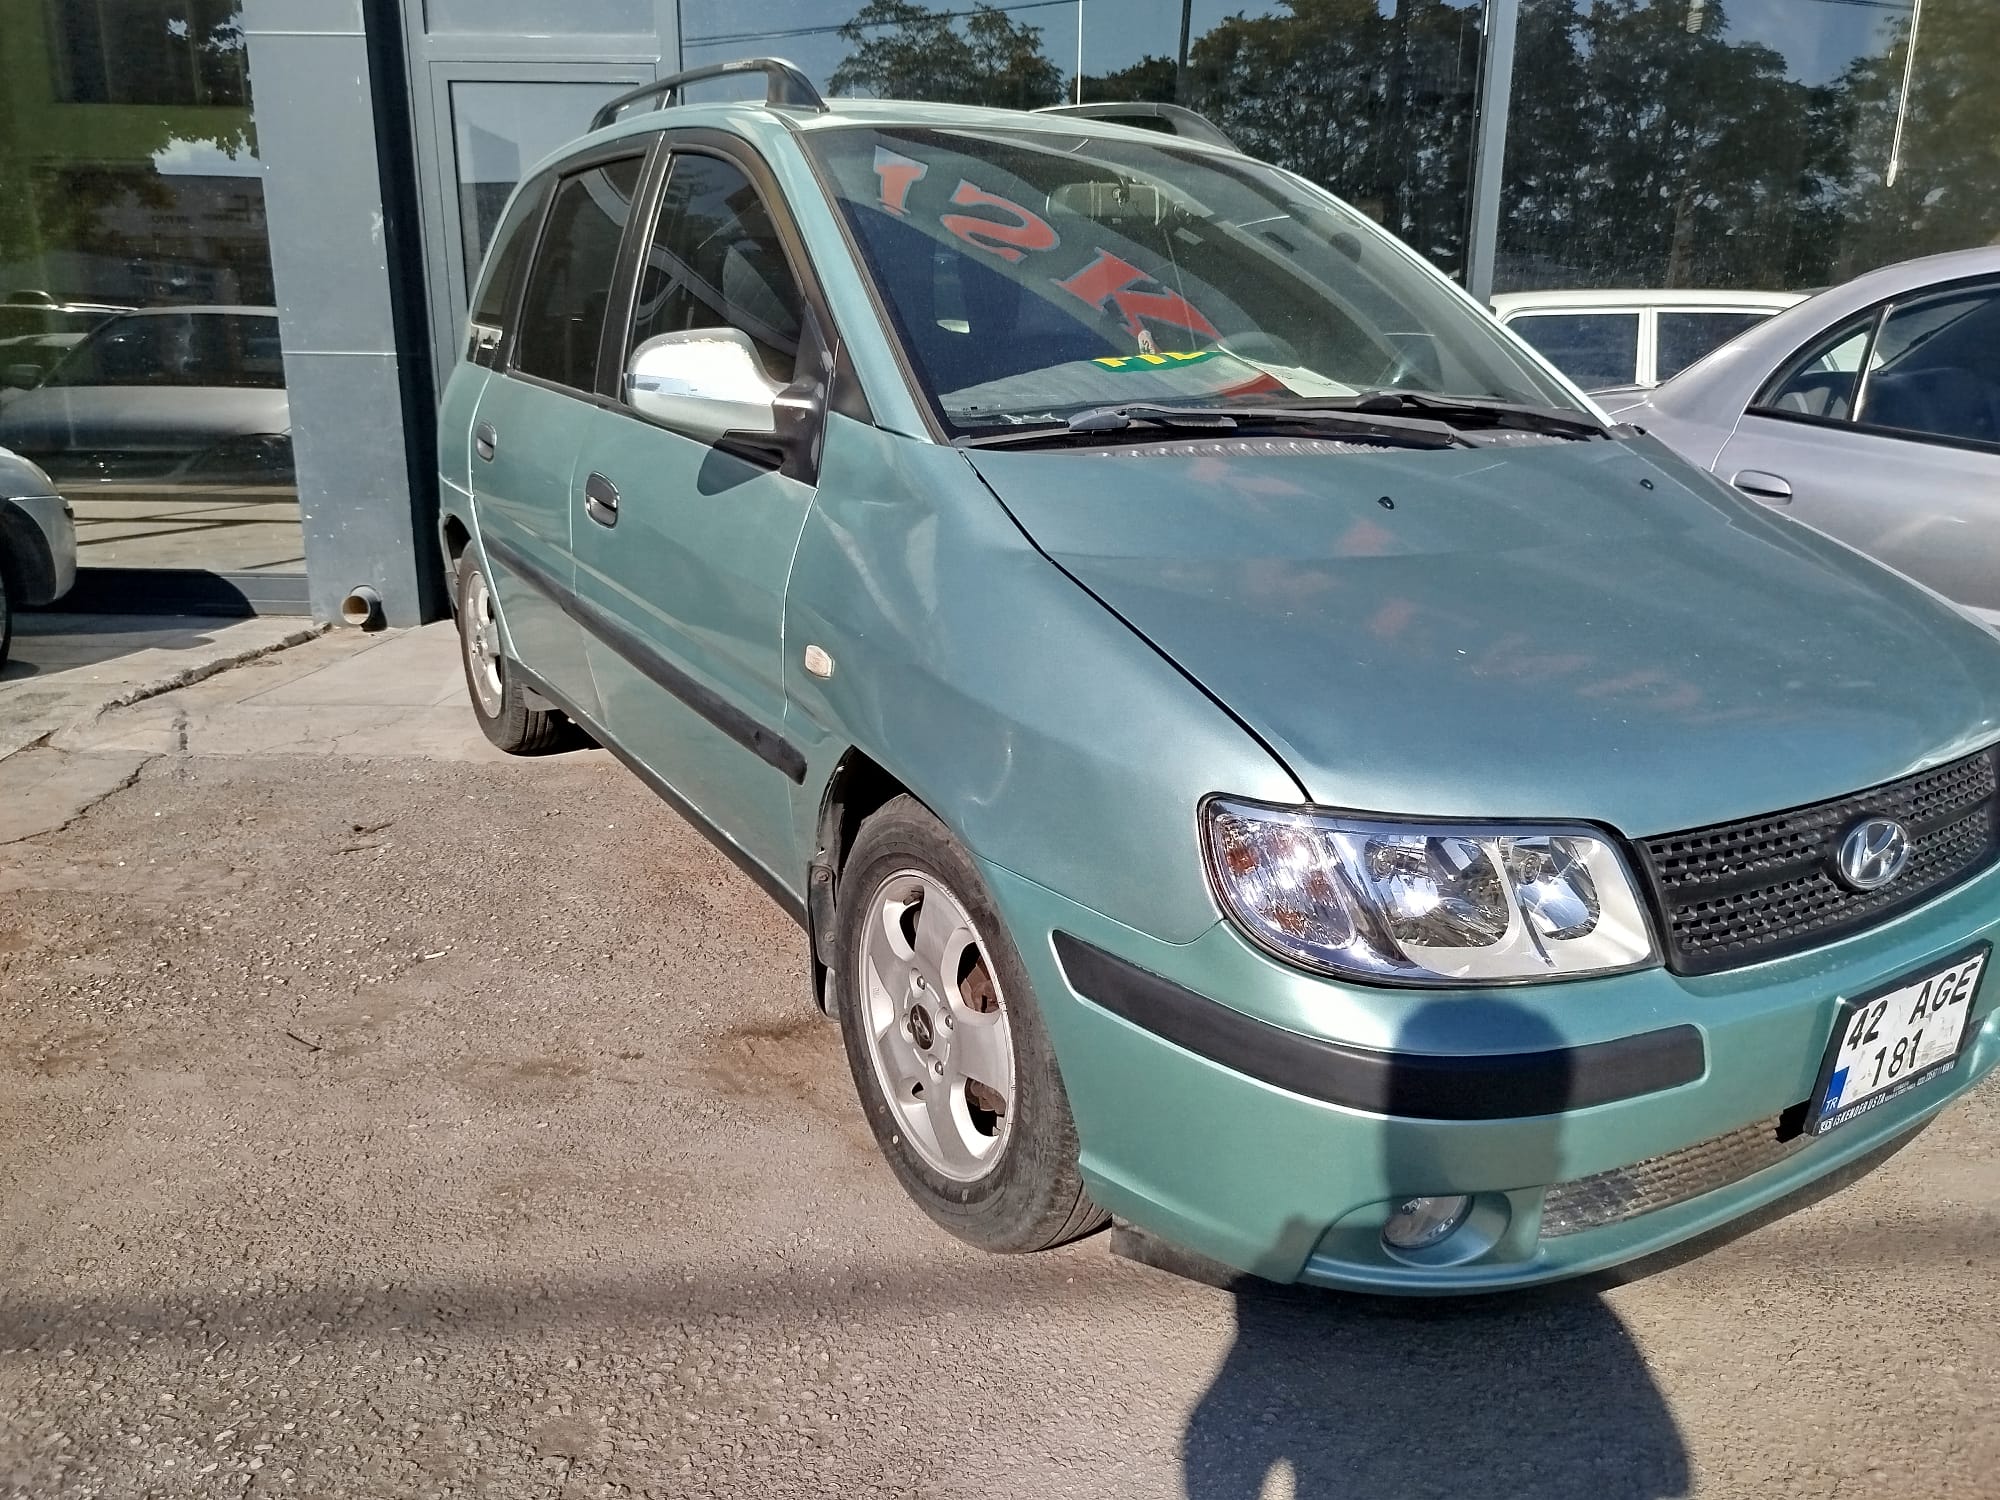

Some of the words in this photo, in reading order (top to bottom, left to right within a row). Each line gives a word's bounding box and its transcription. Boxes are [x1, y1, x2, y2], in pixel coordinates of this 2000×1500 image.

[1847, 1000, 1888, 1050] 42
[1908, 962, 1979, 1025] AGE
[1871, 1028, 1924, 1087] 181
[1825, 1096, 1839, 1112] TR
